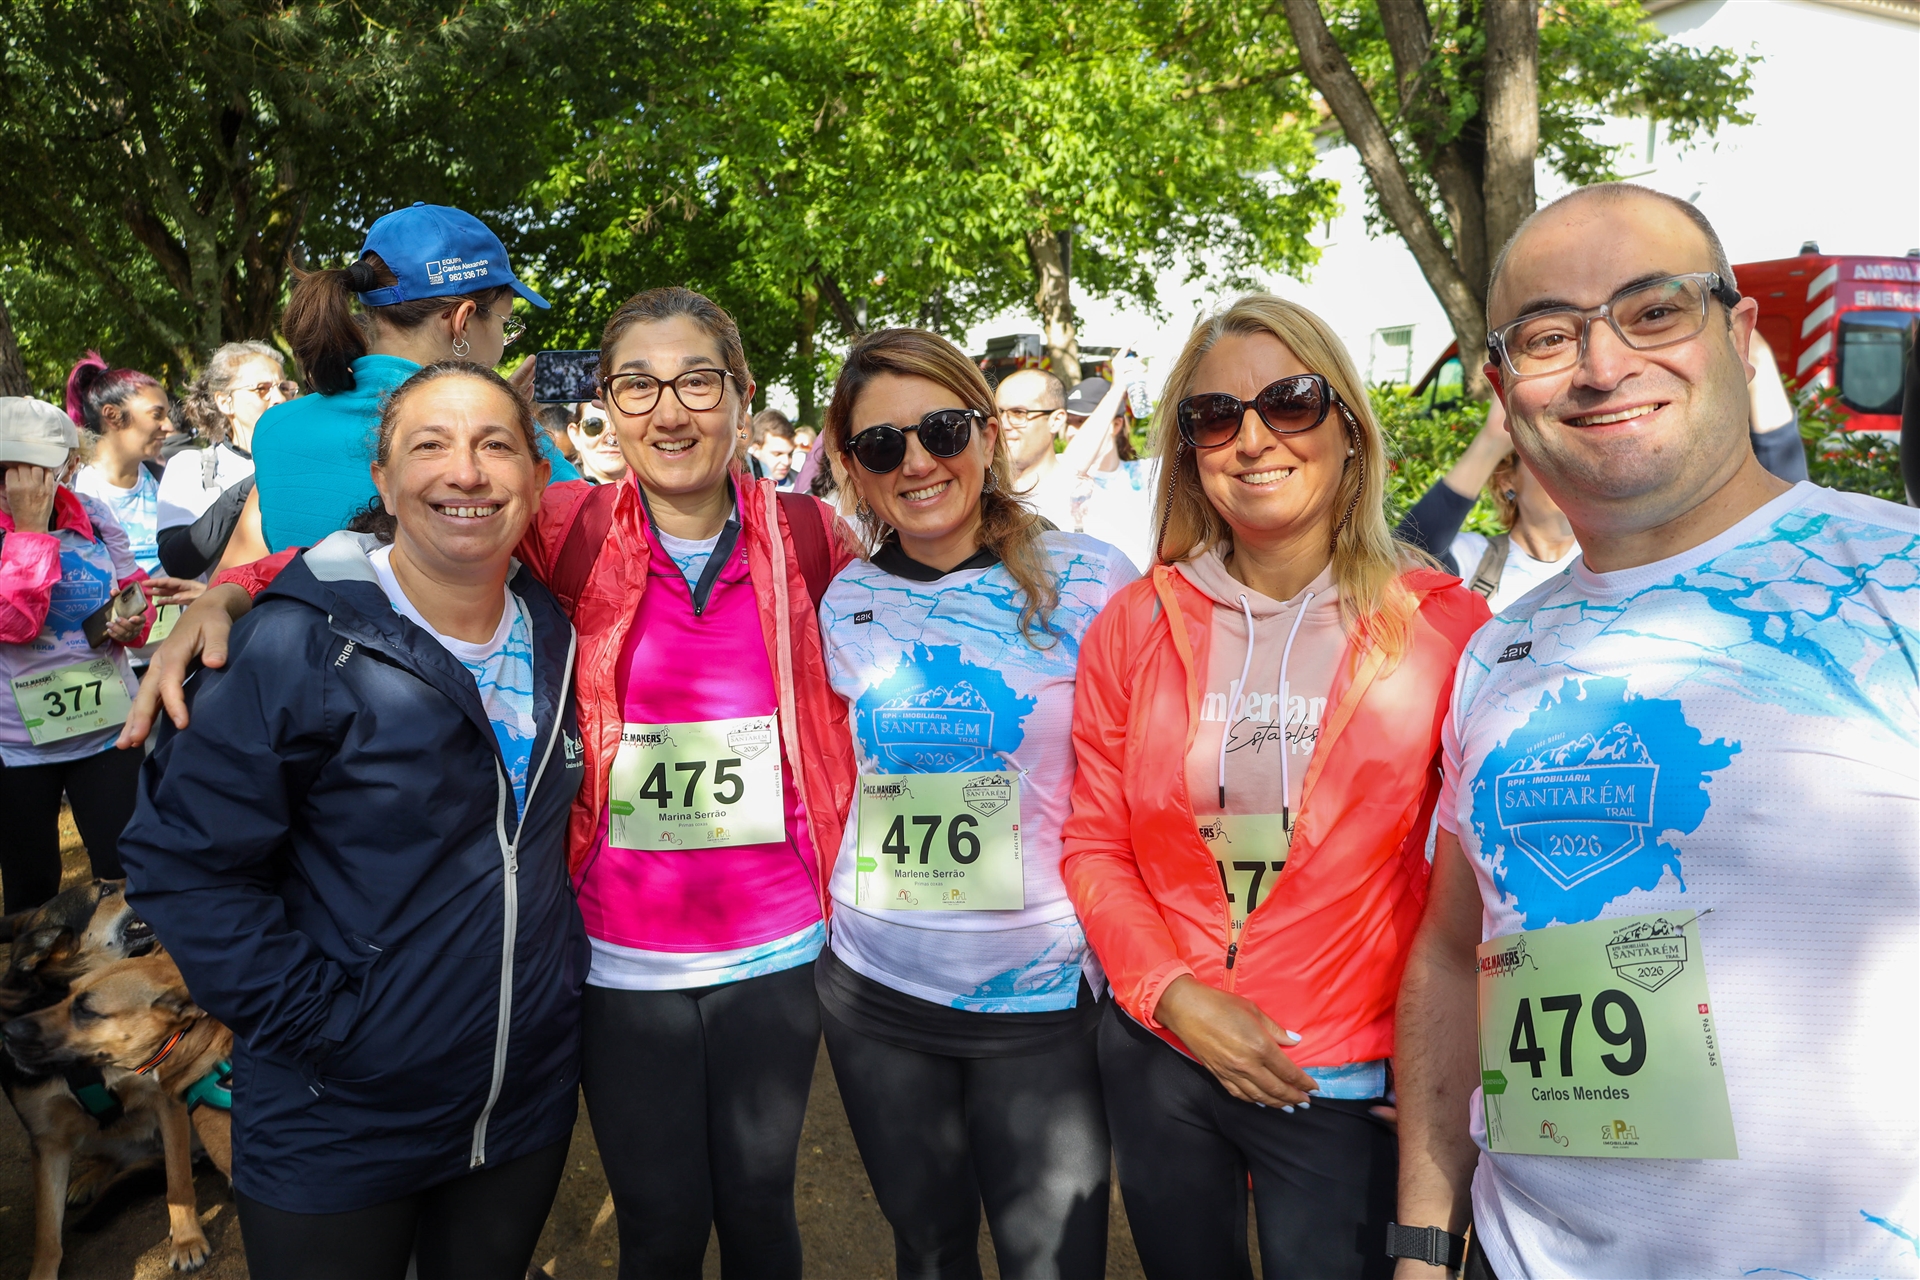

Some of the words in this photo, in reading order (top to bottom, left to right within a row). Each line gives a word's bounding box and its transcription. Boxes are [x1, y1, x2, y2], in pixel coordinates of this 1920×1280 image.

[442, 258, 462, 266] EQUIPA
[442, 265, 461, 273] Carlos
[462, 259, 489, 270] Alexandre
[1855, 291, 1920, 308] EMERG
[65, 603, 88, 613] 2026
[855, 611, 872, 622] 42K
[43, 680, 102, 717] 377
[66, 713, 83, 721] Maria
[84, 709, 98, 717] Mata
[902, 712, 948, 720] IMOBILIÁRIA
[881, 719, 980, 736] SANTARÉM
[914, 752, 956, 765] 2026
[639, 758, 745, 808] 475
[1507, 778, 1525, 787] RPH
[1532, 773, 1591, 784] IMOBILIÁRIA
[966, 789, 1006, 797] SANTARÉM
[1505, 780, 1636, 808] SANTARÉM
[658, 813, 692, 821] Marina
[694, 810, 727, 819] Serrão
[1605, 807, 1636, 817] TRAIL
[882, 814, 981, 865] 476
[1550, 834, 1602, 857] 2026
[895, 869, 930, 878] Marlene
[932, 869, 965, 878] Serrão
[1231, 920, 1245, 930] éli
[1613, 944, 1679, 960] SANTARÉM
[1638, 966, 1664, 978] 2026
[1702, 1018, 1711, 1033] 963
[1509, 989, 1647, 1078] 479
[1705, 1035, 1714, 1050] 939
[1708, 1051, 1717, 1067] 365
[1532, 1087, 1570, 1101] Carlos
[1573, 1085, 1630, 1100] Mendes
